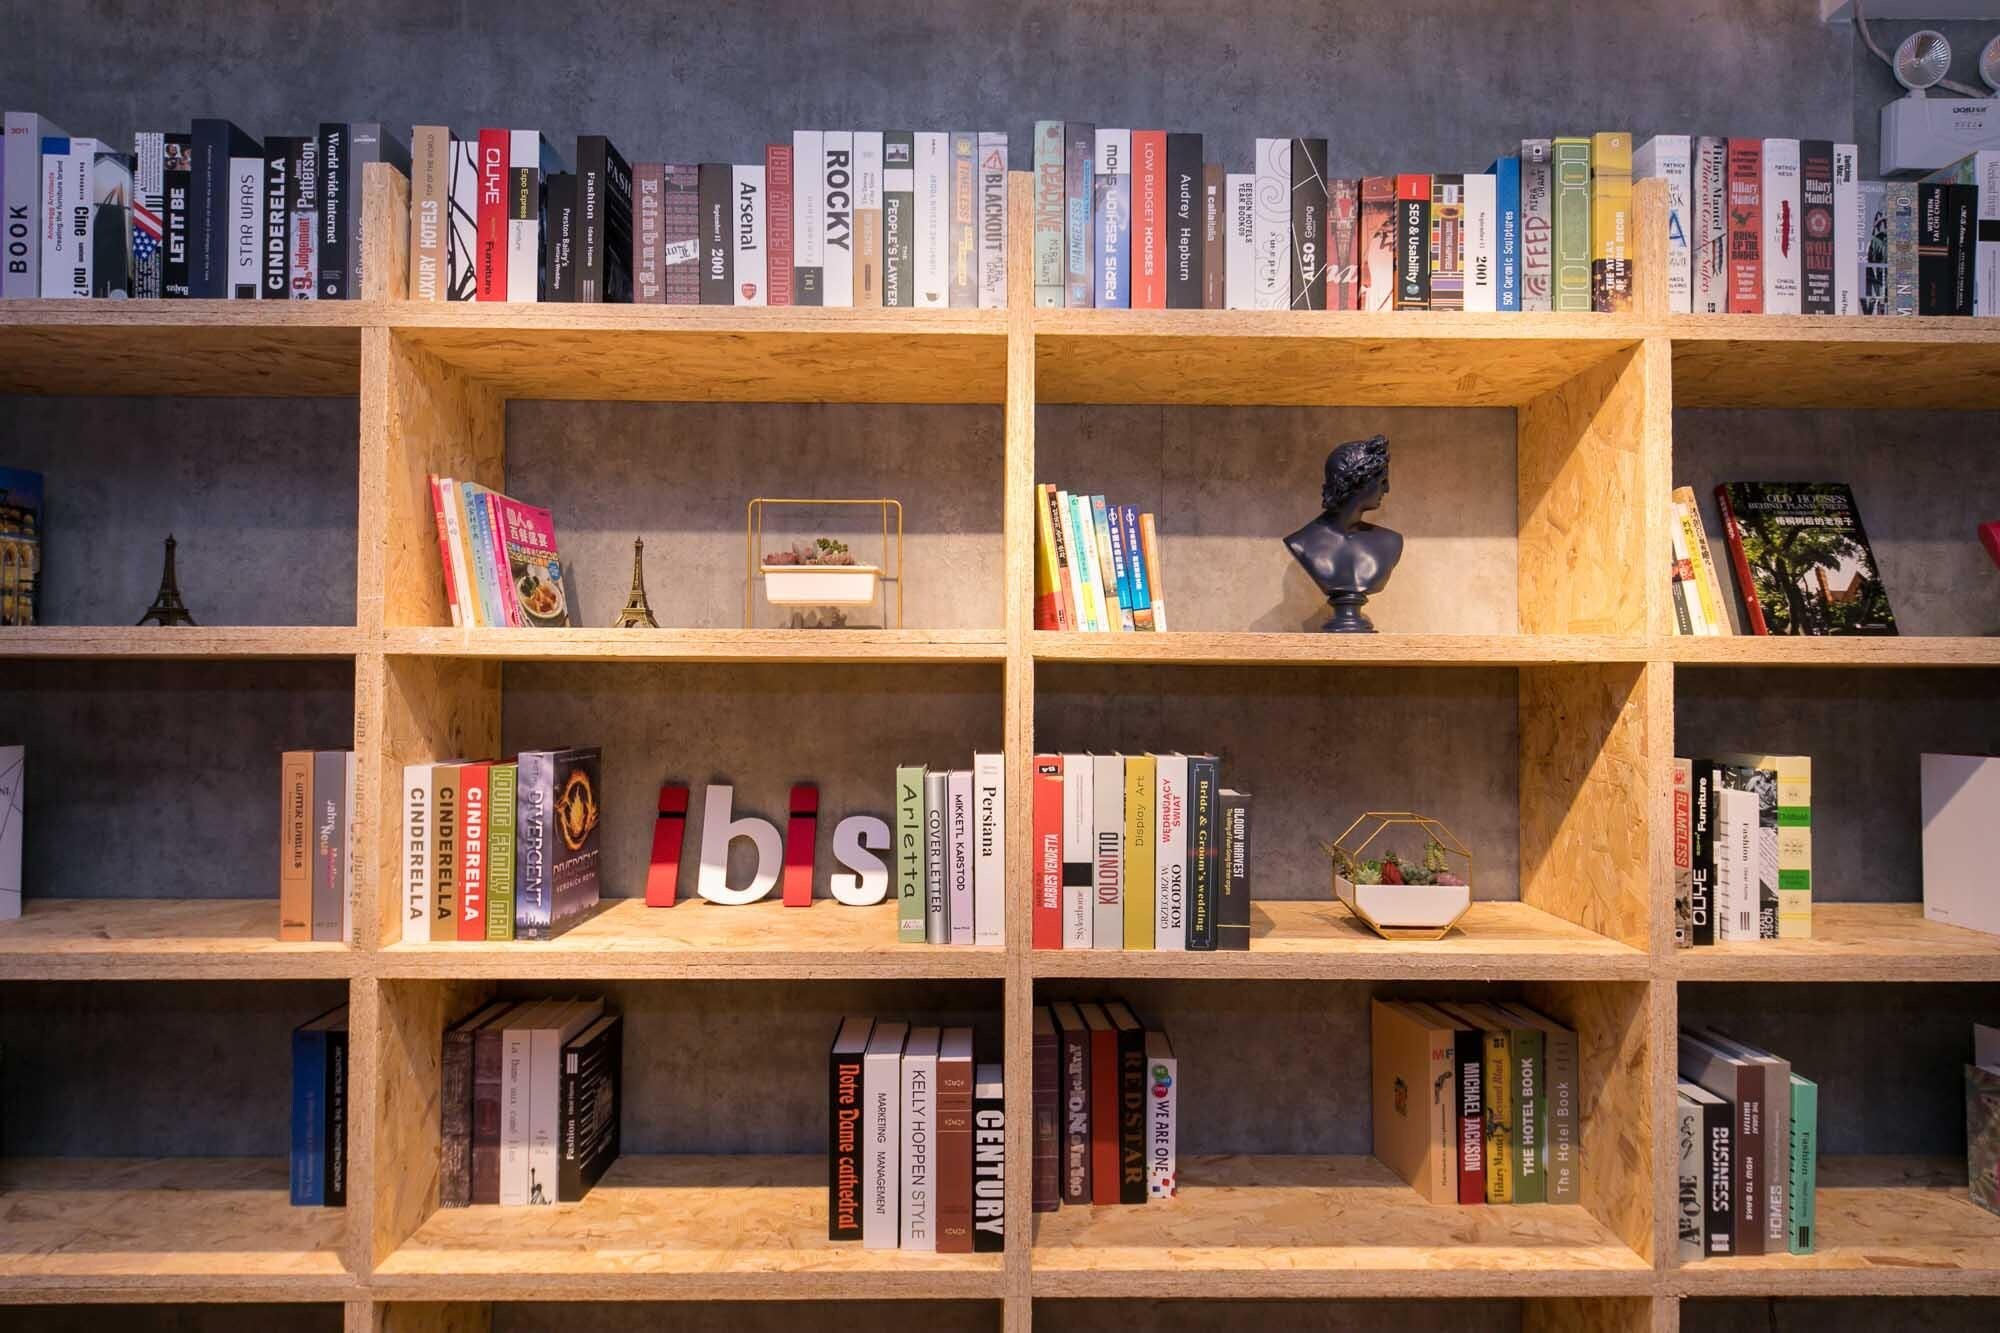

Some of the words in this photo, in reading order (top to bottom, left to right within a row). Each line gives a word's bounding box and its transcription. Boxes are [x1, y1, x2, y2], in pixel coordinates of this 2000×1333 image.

[327, 132, 339, 169] World
[1143, 143, 1154, 173] LOW
[1712, 145, 1723, 184] Hilary
[240, 174, 254, 219] WARS
[297, 142, 316, 209] Patterson
[327, 171, 339, 198] wide
[520, 168, 529, 187] Expo
[587, 172, 596, 219] Fashion
[1177, 174, 1191, 219] Audrey
[1702, 158, 1711, 192] Place
[1732, 181, 1758, 193] Hilary
[1805, 180, 1832, 193] Hilary
[73, 206, 89, 237] Cine
[170, 188, 184, 210] BE
[170, 213, 184, 229] IT
[327, 199, 338, 244] internet
[520, 188, 529, 219] Express
[740, 181, 757, 251] Arsenal
[826, 150, 850, 251] ROCKY
[985, 173, 1003, 251] BLACKOUT
[1143, 174, 1154, 225] BUDGET
[1409, 203, 1420, 225] SEO
[1712, 187, 1723, 230] Mantel
[9, 204, 29, 274] BOOK
[56, 223, 64, 251] Creating
[240, 224, 254, 267] STAR
[269, 157, 286, 290] CINDERELLA
[421, 200, 438, 249] HOTELS
[562, 208, 570, 238] Preston
[639, 178, 660, 297] Edinburgh
[887, 199, 899, 258] PEOPLE'S
[1409, 226, 1420, 235] &
[1503, 211, 1514, 254] Sculptures
[1525, 215, 1550, 269] FEED
[170, 233, 184, 263] LET
[561, 239, 570, 267] Bailey's
[711, 248, 725, 280] 2001
[1143, 227, 1154, 277] HOUSES
[1177, 228, 1191, 281] Hepburn
[1302, 243, 1315, 281] ALSO
[1406, 237, 1420, 284] Usability
[1476, 255, 1487, 286] 2001
[73, 267, 89, 297] noi?
[419, 256, 436, 302] UXURY
[887, 258, 899, 306] LAWYER
[1503, 257, 1513, 289] Ceramic
[1503, 291, 1513, 306] 500
[492, 769, 513, 827] LOVING
[1134, 775, 1145, 796] Art
[1199, 780, 1209, 812] Bride
[1697, 777, 1708, 832] Furniture
[929, 809, 941, 857] COVER
[955, 794, 965, 838] MIKKETL
[982, 786, 997, 857] Persiana
[1134, 804, 1146, 847] Display
[1199, 815, 1208, 827] &
[1233, 808, 1245, 841] BLOODY
[1674, 791, 1688, 867] BLAMELESS
[410, 788, 425, 920] CINDERELLA
[437, 787, 454, 920] CINDERELLA
[464, 787, 482, 921] CINDERELLA
[490, 832, 511, 894] FAMILY
[525, 790, 544, 908] DIVERGENT
[645, 784, 891, 908] ibis
[903, 784, 919, 899] Arletta
[1043, 833, 1059, 873] VENDETTA
[1198, 829, 1208, 881] Groom's
[1233, 841, 1245, 879] HARVEST
[930, 862, 942, 913] LETTER
[956, 843, 965, 892] KARSTOD
[1098, 832, 1119, 905] KOLONITID
[1043, 873, 1059, 909] BARBIES
[1160, 877, 1169, 929] GRZEGORZ
[1170, 863, 1182, 929] KOŁODKO
[1195, 884, 1207, 932] wedding
[488, 900, 510, 938] MAN
[839, 1064, 860, 1104] Notre
[912, 1070, 926, 1117] KELLY
[1464, 1062, 1480, 1116] MICHAEL
[1521, 1058, 1534, 1097] BOOK
[1556, 1081, 1569, 1116] Book
[839, 1109, 860, 1153] Dame
[876, 1092, 887, 1144] MARKETING
[1156, 1099, 1170, 1119] WE
[1522, 1101, 1535, 1151] HOTEL
[566, 1119, 575, 1160] Fashion
[912, 1121, 926, 1185] HOPPEN
[1156, 1121, 1169, 1146] ARE
[1464, 1118, 1481, 1172] JACKSON
[1557, 1124, 1569, 1161] Hotel
[975, 1109, 1004, 1235] CENTURY
[1156, 1147, 1169, 1172] ONE
[1522, 1152, 1535, 1176] THE
[1557, 1168, 1570, 1194] The
[1711, 1127, 1729, 1213] BUSINESS
[1745, 1156, 1753, 1179] HOW
[838, 1156, 859, 1230] cathedral
[876, 1152, 887, 1215] MANAGEMENT
[1745, 1182, 1753, 1193] TO
[912, 1190, 926, 1239] STYLE
[1770, 1185, 1783, 1239] HOMES
